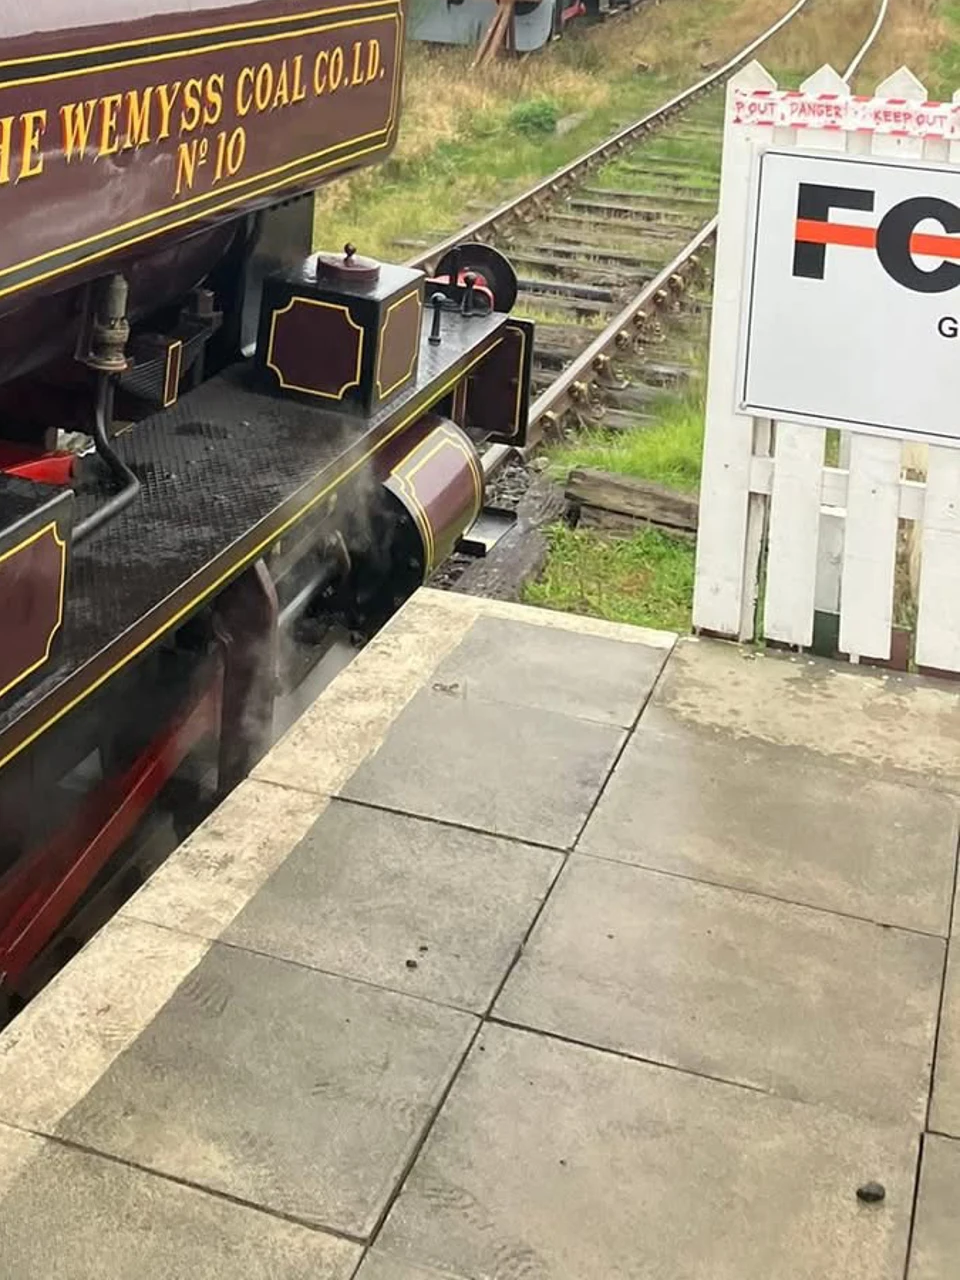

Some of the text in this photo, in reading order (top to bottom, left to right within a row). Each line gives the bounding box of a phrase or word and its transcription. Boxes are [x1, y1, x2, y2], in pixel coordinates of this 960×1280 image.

[59, 72, 223, 162] WEMYSS
[236, 54, 306, 116] COAL
[873, 110, 947, 126] KEEP OUT
[212, 127, 245, 186] 10
